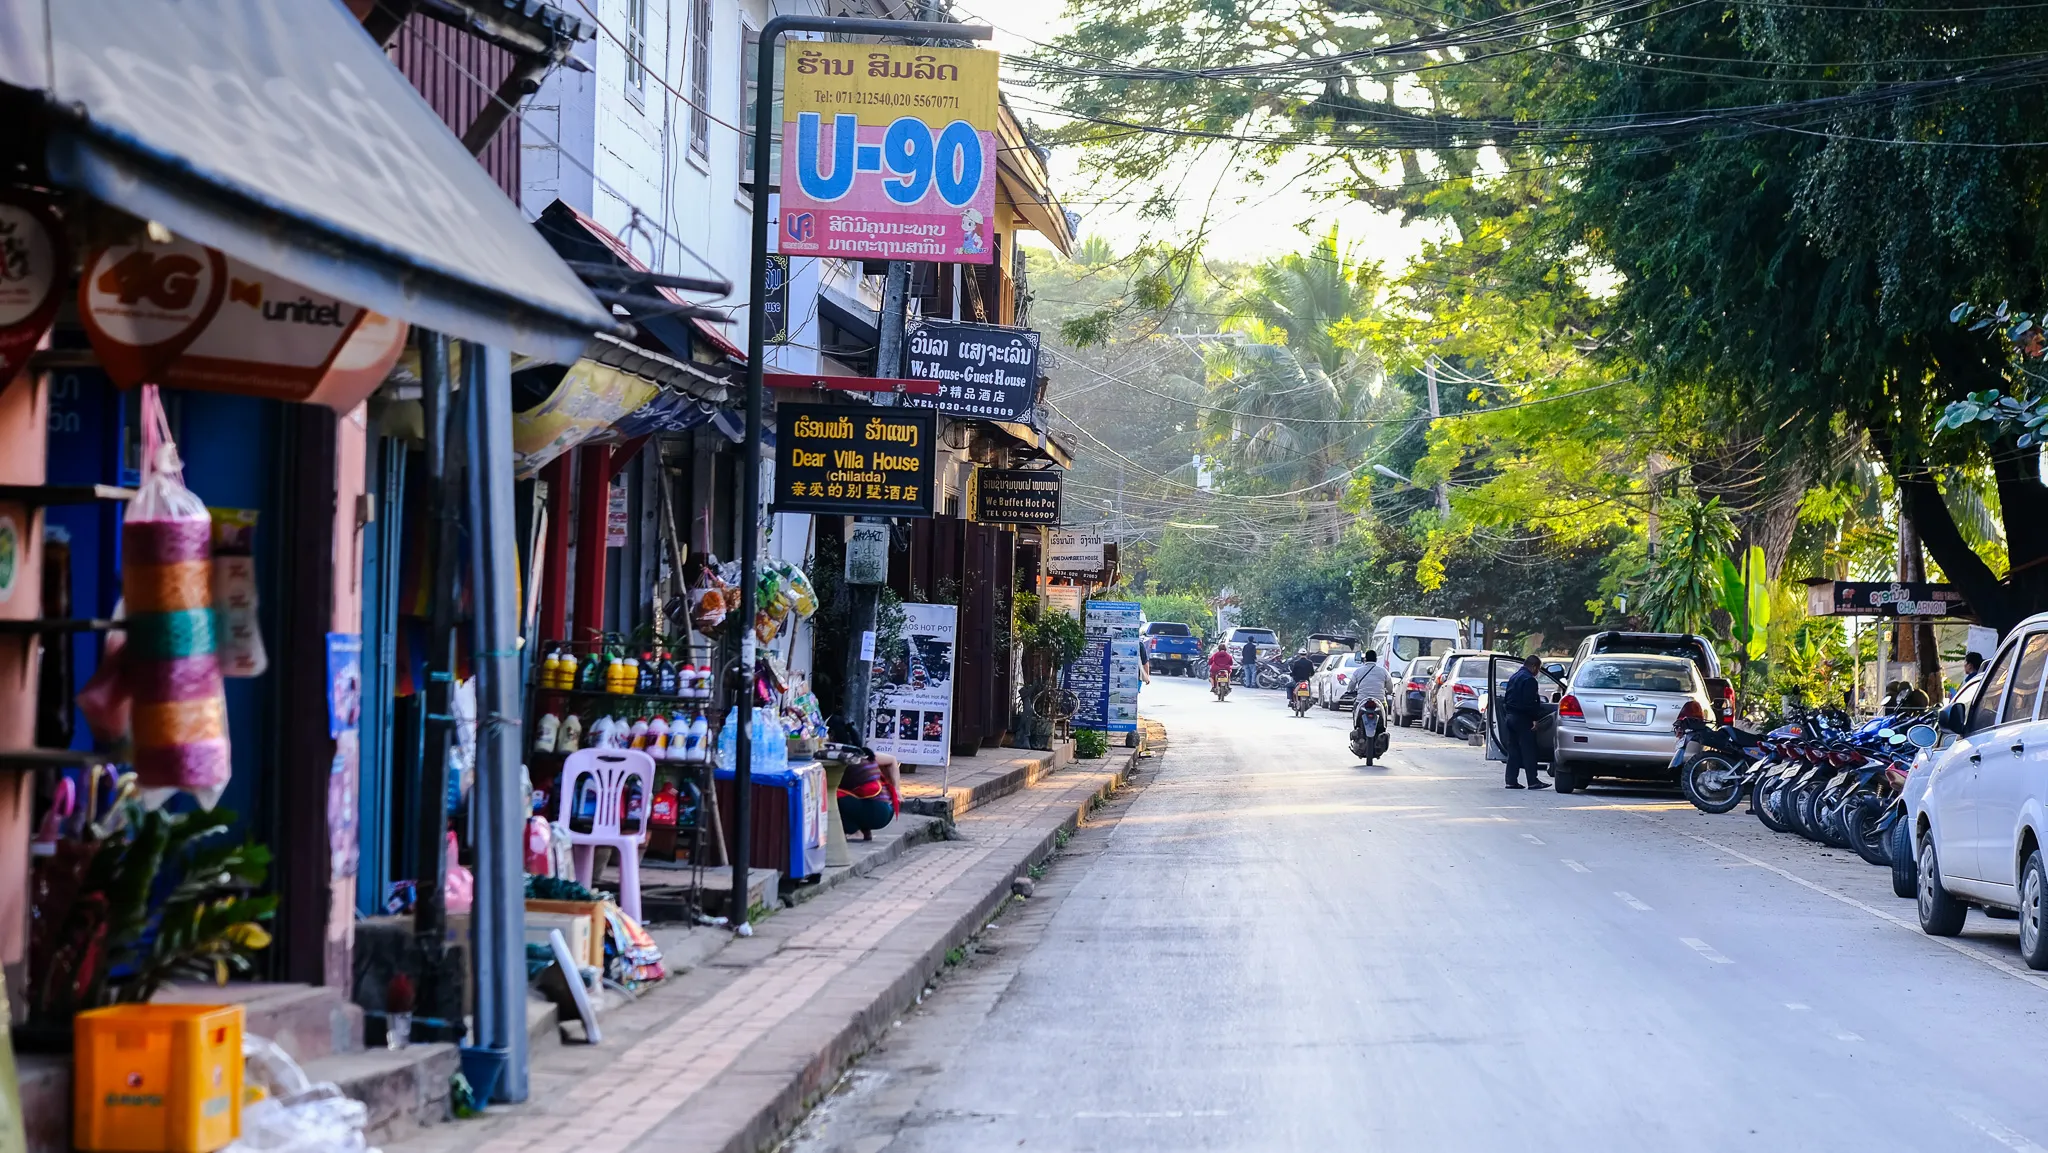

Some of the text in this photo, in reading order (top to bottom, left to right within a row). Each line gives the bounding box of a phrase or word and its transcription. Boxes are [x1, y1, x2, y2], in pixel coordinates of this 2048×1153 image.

[797, 50, 854, 76] ຮ້ານ
[814, 90, 959, 109] Tel: 071 212540,020 55670771
[795, 111, 984, 208] U-90
[97, 252, 204, 310] 4G
[262, 296, 345, 328] unitel
[911, 360, 928, 377] We
[994, 369, 1026, 387] House
[794, 415, 918, 447] ເຮືອນພັກ ຮັກແພງ
[792, 449, 920, 472] Dear Villa House
[826, 470, 886, 484] (chilatda)
[791, 481, 918, 501] 亲爱的别墅酒店
[986, 497, 1055, 508] We Buffet Hot Pot
[1897, 601, 1916, 614] CHA
[1917, 601, 1946, 615] ARNON
